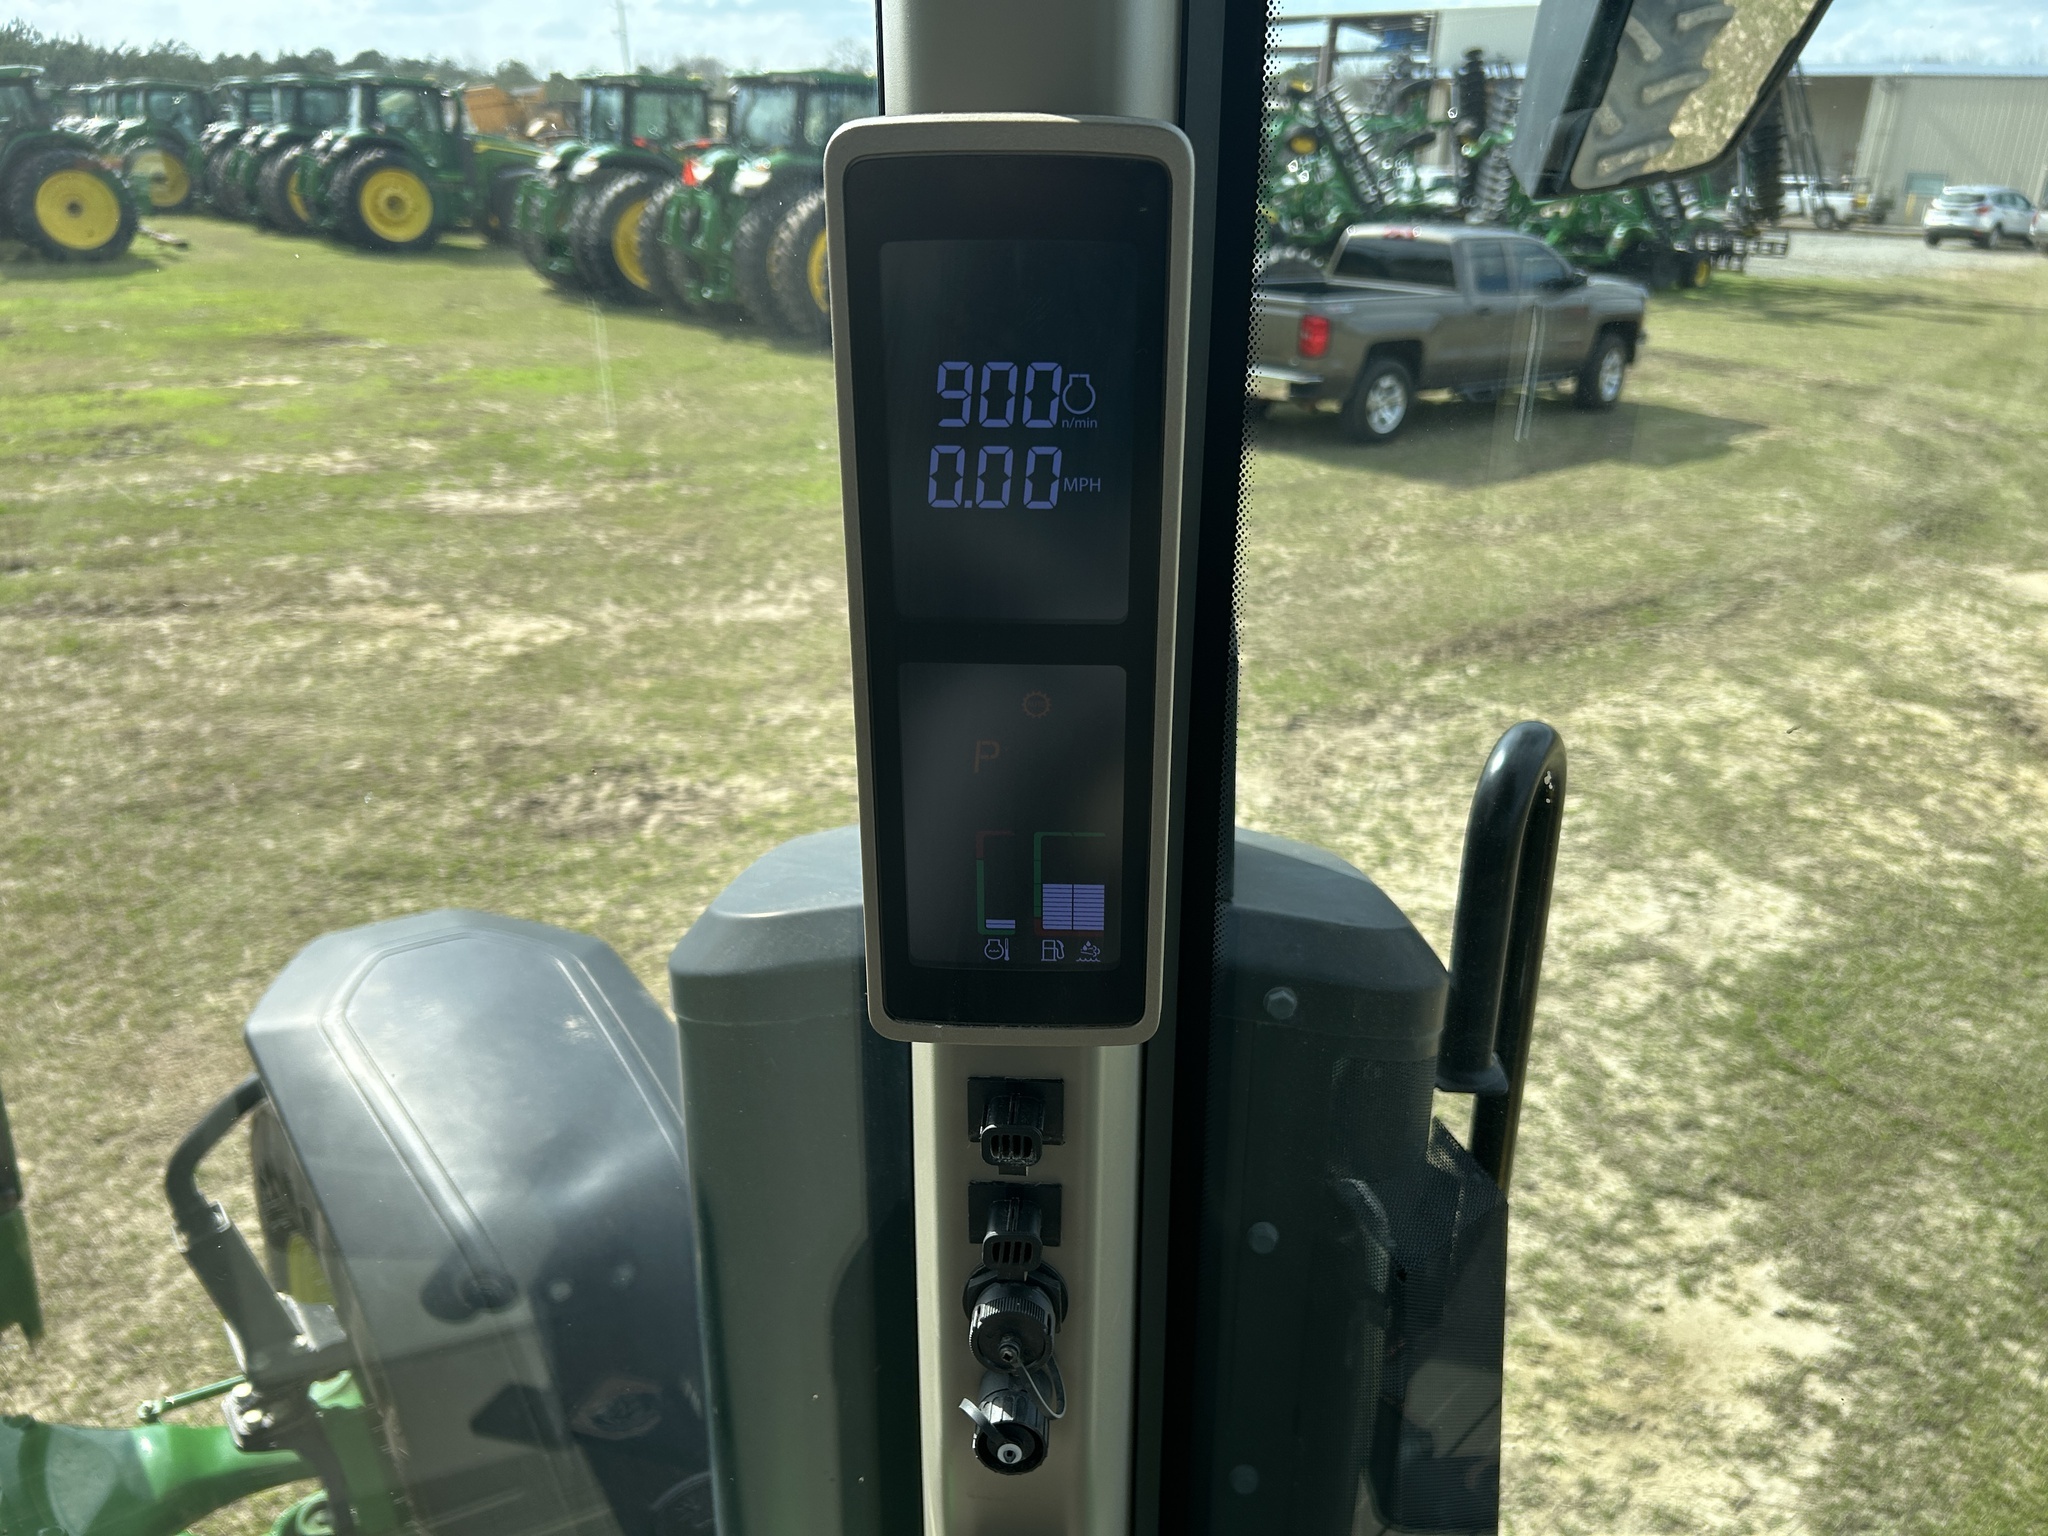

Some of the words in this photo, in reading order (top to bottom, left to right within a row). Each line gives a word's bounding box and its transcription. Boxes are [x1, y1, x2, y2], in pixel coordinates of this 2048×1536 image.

[936, 361, 1063, 429] 900
[1061, 417, 1098, 430] n/min
[928, 445, 1063, 510] 0.00
[1063, 477, 1101, 493] MPH
[972, 739, 1002, 775] P
